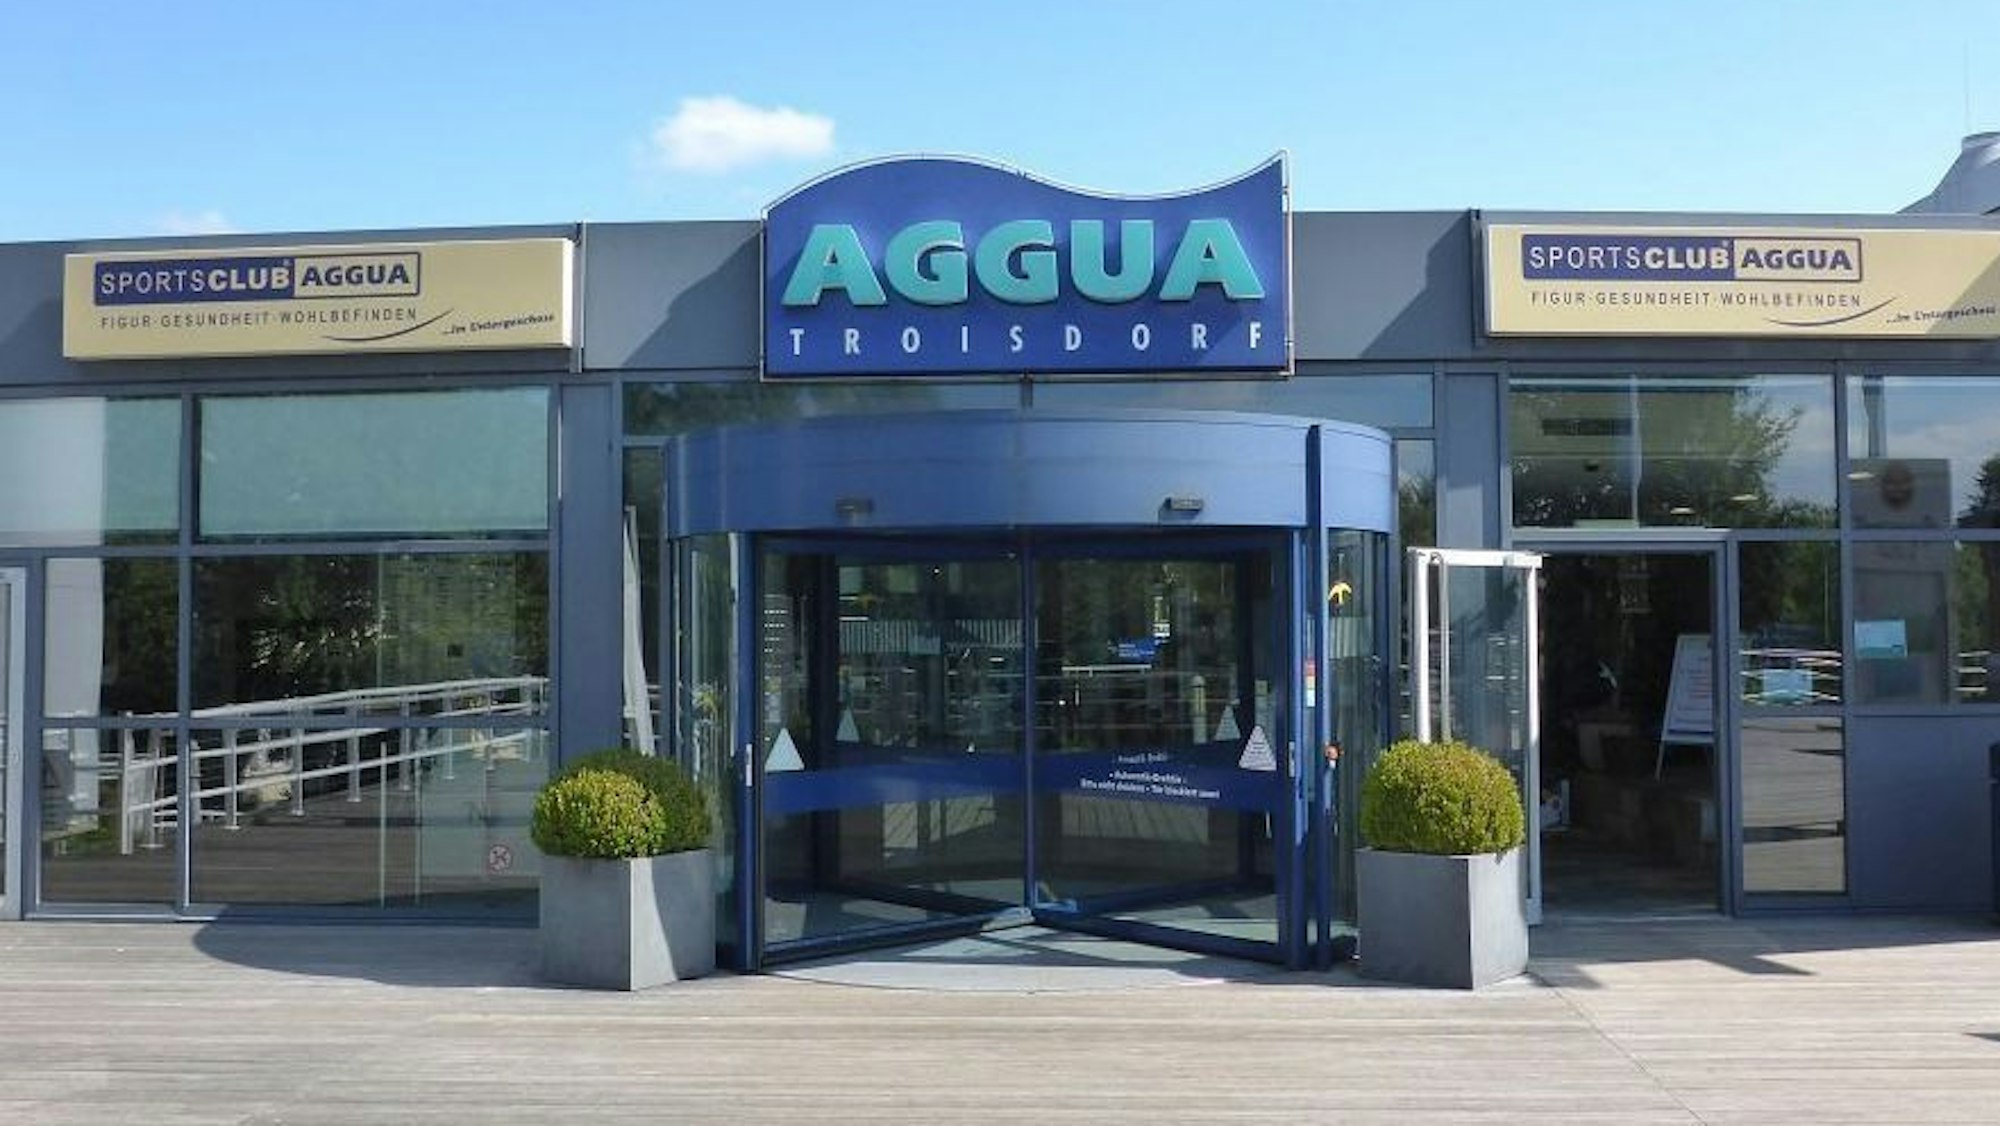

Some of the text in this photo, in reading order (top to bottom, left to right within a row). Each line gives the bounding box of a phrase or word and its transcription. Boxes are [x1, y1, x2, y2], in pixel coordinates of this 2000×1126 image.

[780, 219, 1266, 306] AGGUA
[1741, 247, 1853, 271] AGGUA
[301, 264, 410, 286] AGGUA
[789, 321, 1262, 356] TROISDORF
